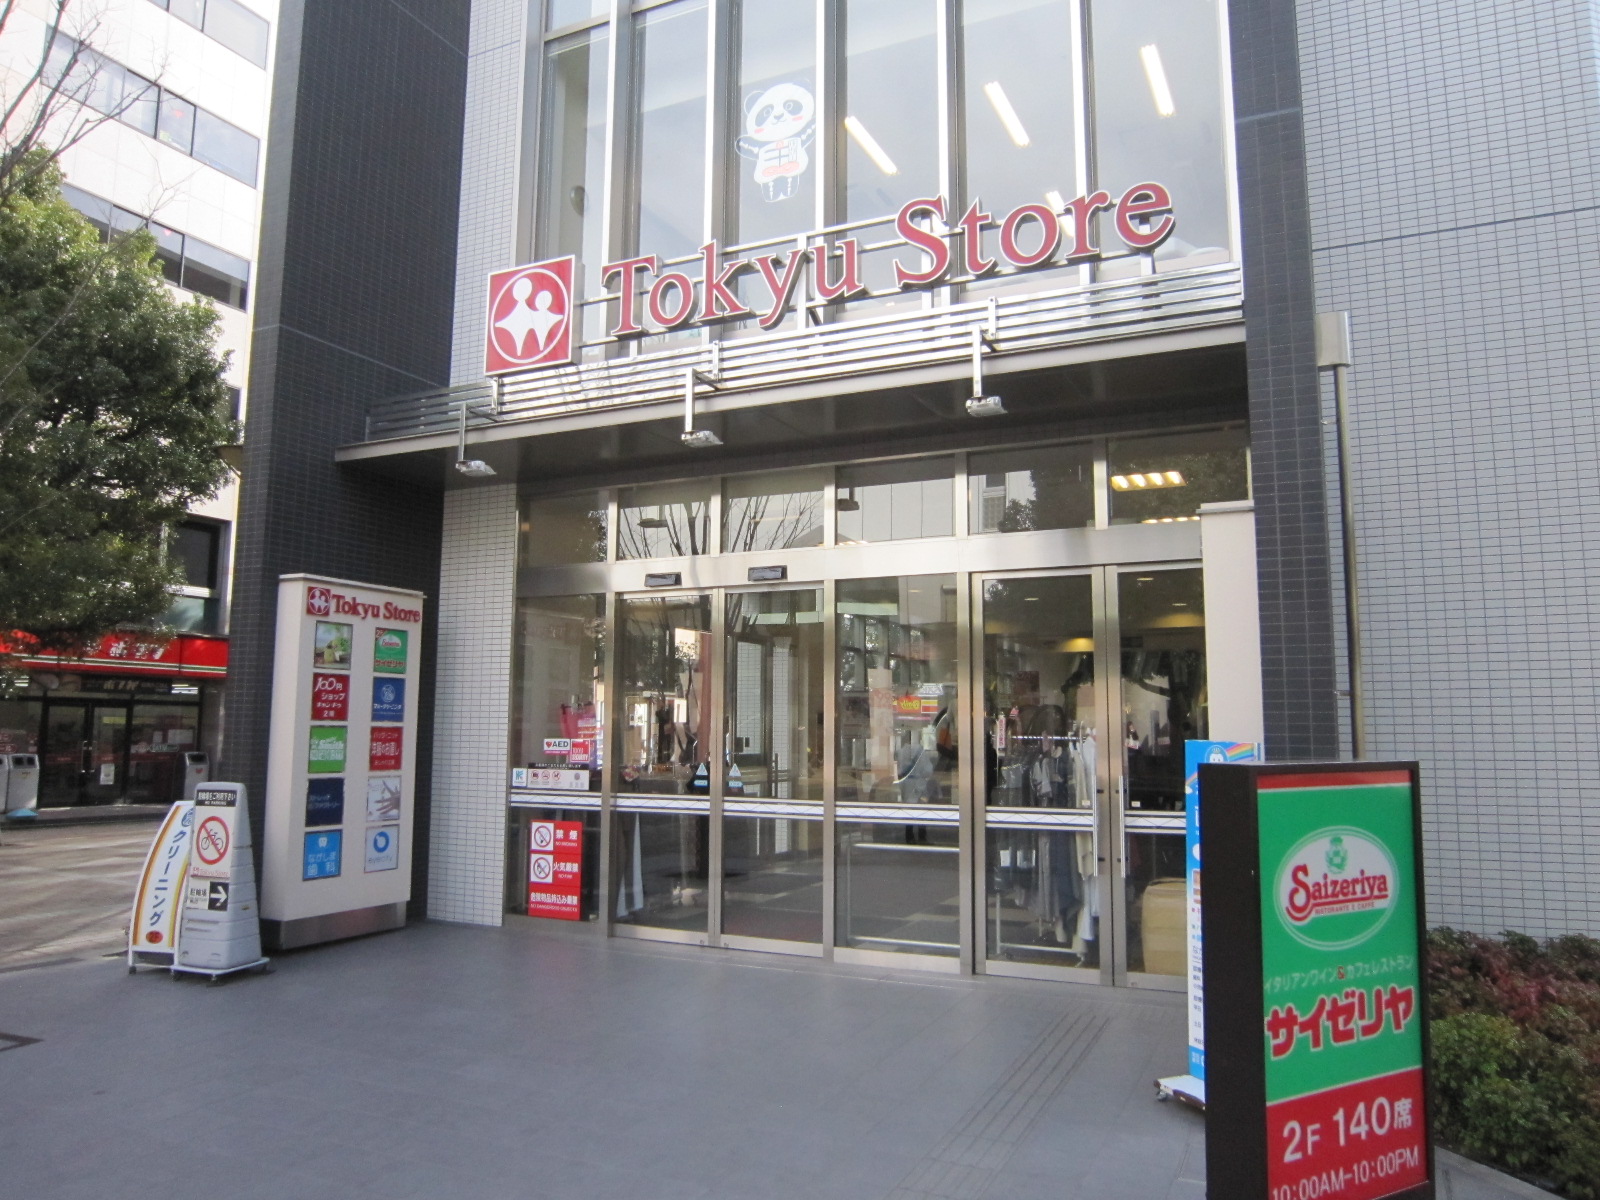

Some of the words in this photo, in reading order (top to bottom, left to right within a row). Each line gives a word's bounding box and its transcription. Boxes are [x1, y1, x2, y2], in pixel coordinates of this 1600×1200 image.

[602, 239, 865, 337] Tokyu
[894, 181, 1175, 291] Store
[331, 594, 381, 619] Tokyu
[383, 602, 421, 622] Store
[555, 829, 578, 840] 禁煙
[150, 830, 186, 927] クリーニング
[308, 861, 335, 876] 歯科
[553, 861, 579, 873] 火気厳禁
[1286, 864, 1389, 922] Saizeriya
[1315, 906, 1350, 915] RISTORANTE
[1265, 984, 1414, 1061] サイゼリヤ
[1283, 1120, 1321, 1163] 2F
[1333, 1097, 1412, 1147] 140席
